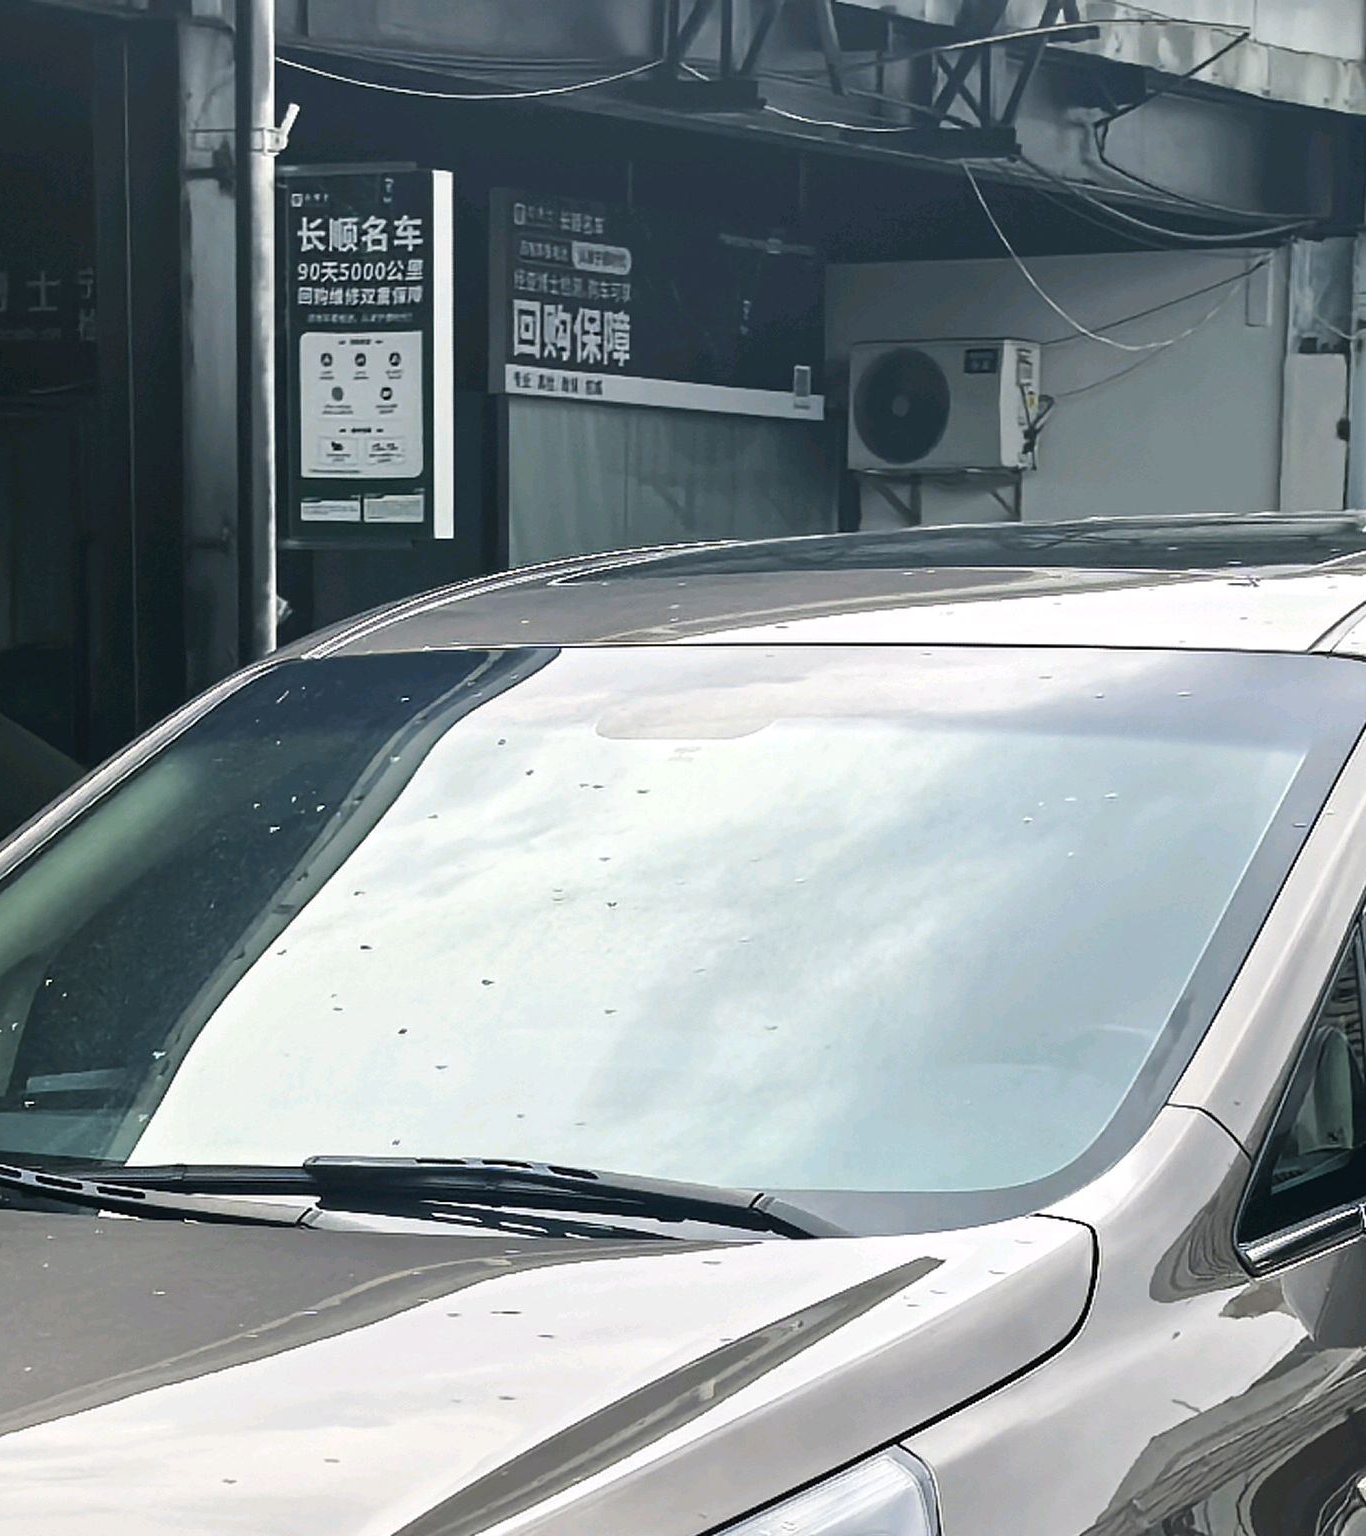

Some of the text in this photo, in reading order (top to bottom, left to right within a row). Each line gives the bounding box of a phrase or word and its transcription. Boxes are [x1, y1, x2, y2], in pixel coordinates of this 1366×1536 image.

[297, 215, 424, 252] 长顺名车
[297, 259, 424, 282] 90天5000公里
[513, 299, 631, 367] 回购保障
